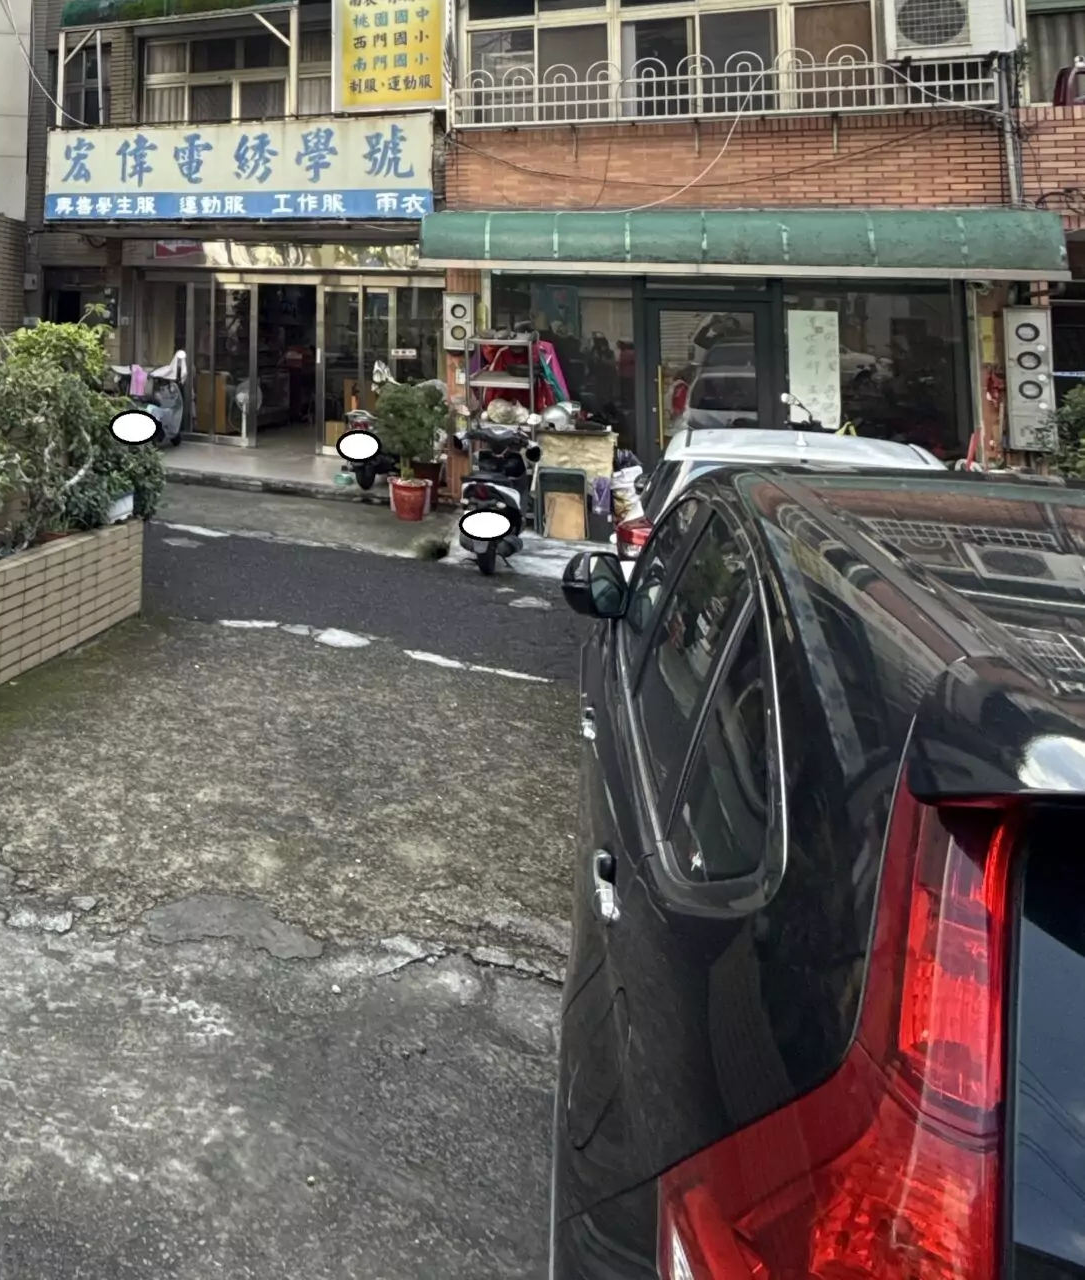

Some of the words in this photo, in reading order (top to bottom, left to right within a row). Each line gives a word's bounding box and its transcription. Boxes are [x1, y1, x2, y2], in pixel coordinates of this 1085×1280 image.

[353, 7, 430, 28] 桃園國中
[353, 30, 429, 49] 西門國小
[353, 53, 429, 72] 南門國小
[179, 195, 247, 215] 運動服
[271, 192, 346, 214] 工作服
[375, 192, 426, 214] 雨衣
